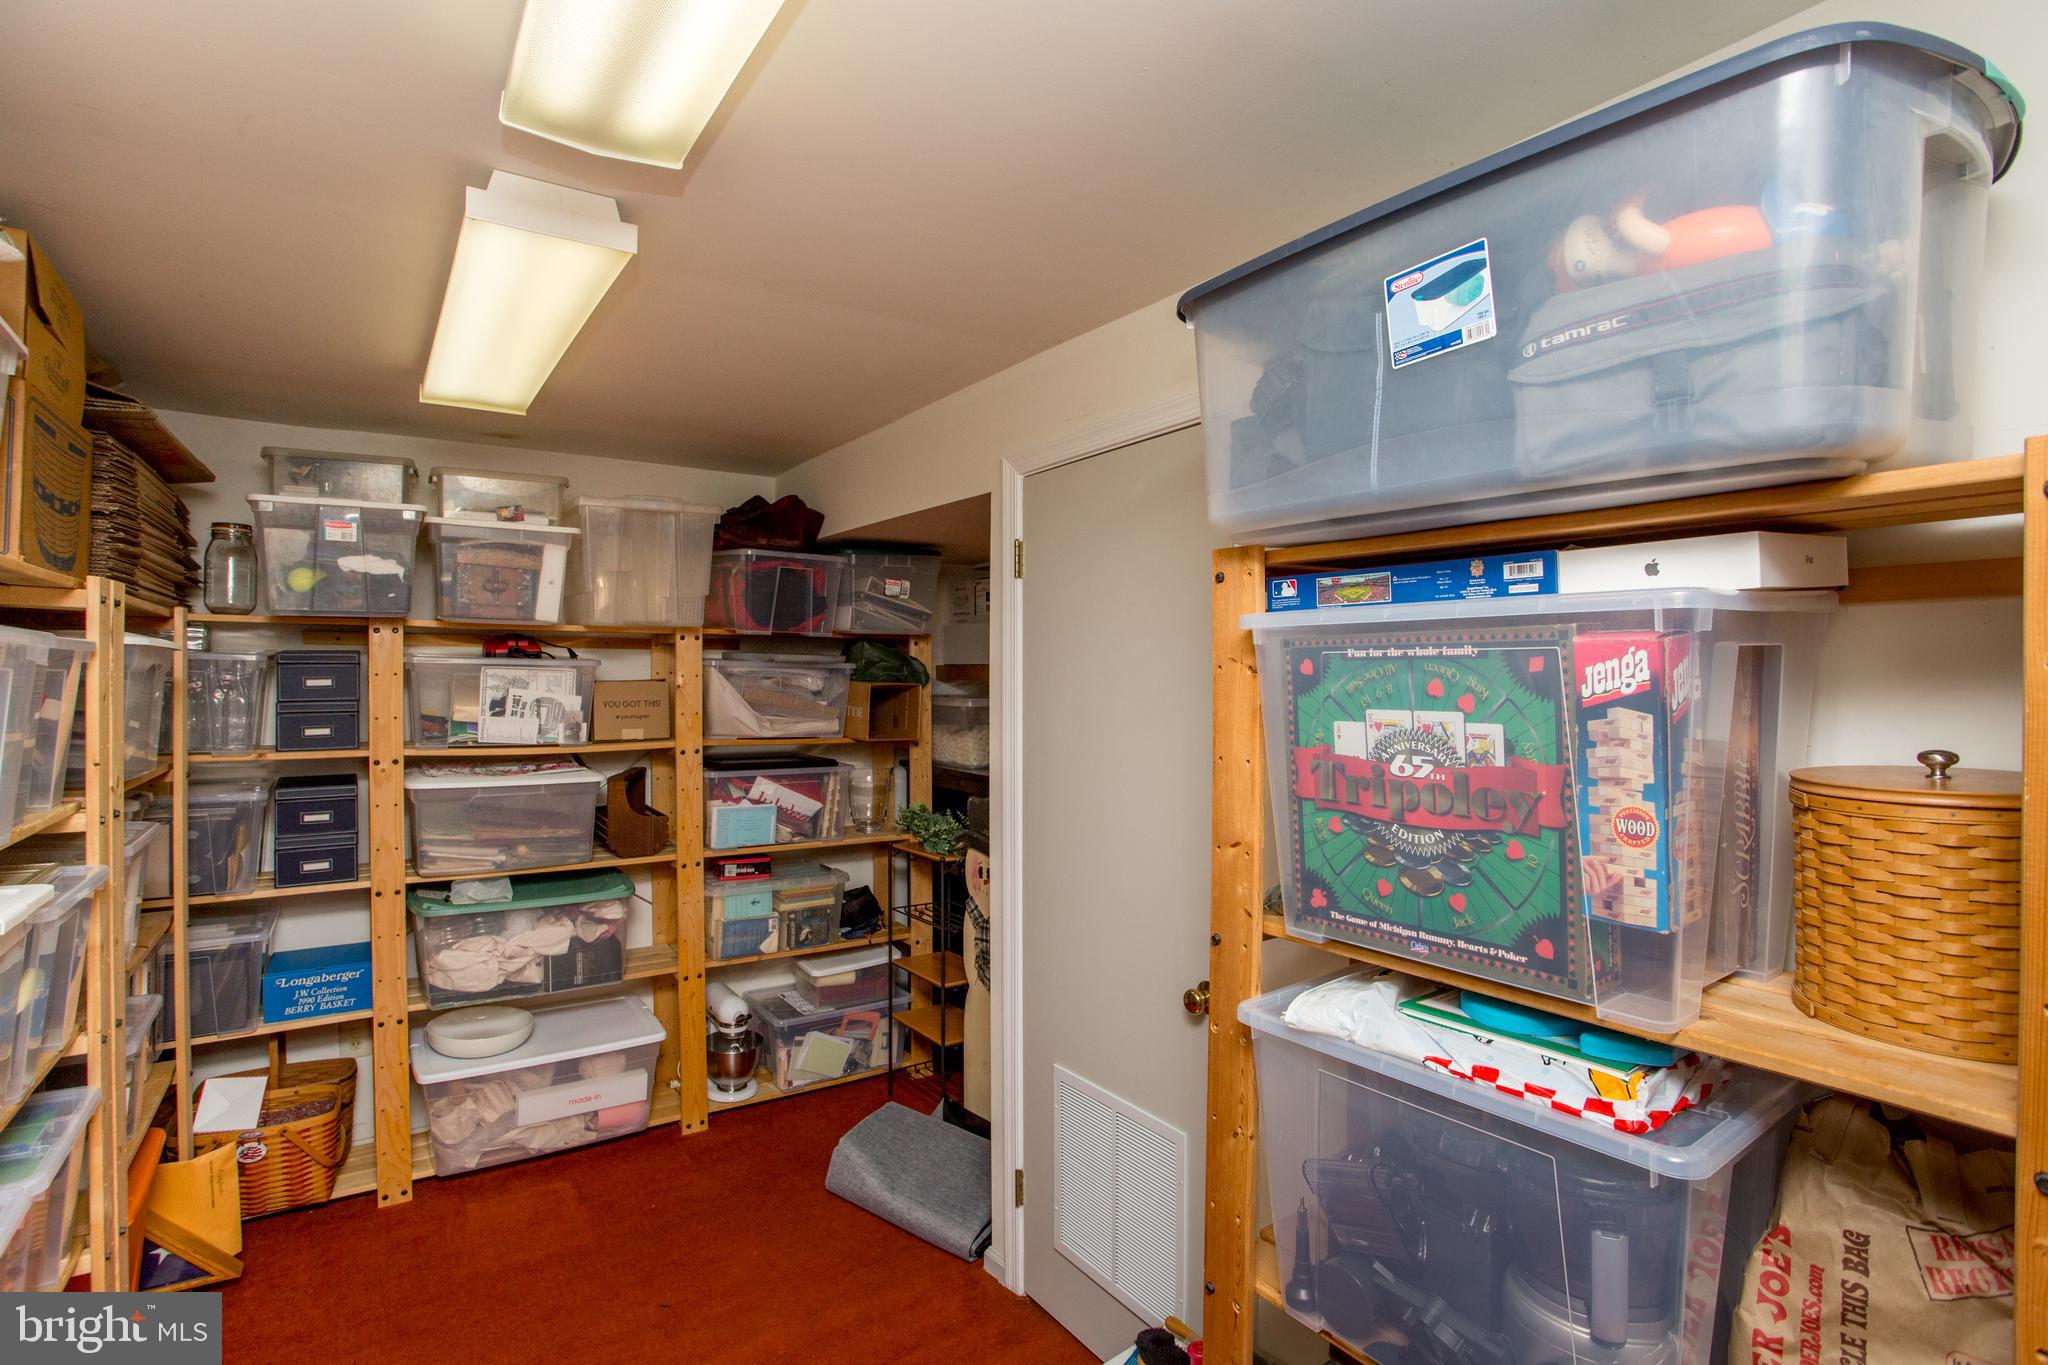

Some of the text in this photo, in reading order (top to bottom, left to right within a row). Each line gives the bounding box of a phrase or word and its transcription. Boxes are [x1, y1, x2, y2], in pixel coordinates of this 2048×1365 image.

[1540, 315, 1628, 349] tamrac
[1347, 645, 1478, 658] Fun for the whole family
[1581, 646, 1651, 698] Jenga
[602, 699, 661, 709] YOU GOT THIS!
[1380, 740, 1451, 768] ANNIVERSARY
[1309, 759, 1545, 836] Tripoley
[1391, 823, 1445, 845] EDITION
[1615, 818, 1656, 837] WOOD
[1361, 887, 1393, 915] Queen
[1453, 912, 1476, 929] Jack
[1329, 910, 1346, 922] The
[1346, 914, 1369, 928] Game
[1369, 919, 1379, 928] of
[1378, 920, 1418, 938] Michigan
[1419, 930, 1456, 948] Rummy,
[1457, 939, 1489, 955] Hearts
[1498, 948, 1529, 964] Poker
[275, 969, 365, 988] Longaberger
[310, 986, 348, 996] Collection
[284, 998, 357, 1015] BERRY BASKET
[298, 994, 345, 1005] 1990 Edition
[1842, 1229, 1872, 1279] BAG
[1756, 1223, 1793, 1325] JOE'S
[1840, 1278, 1869, 1331] THIS
